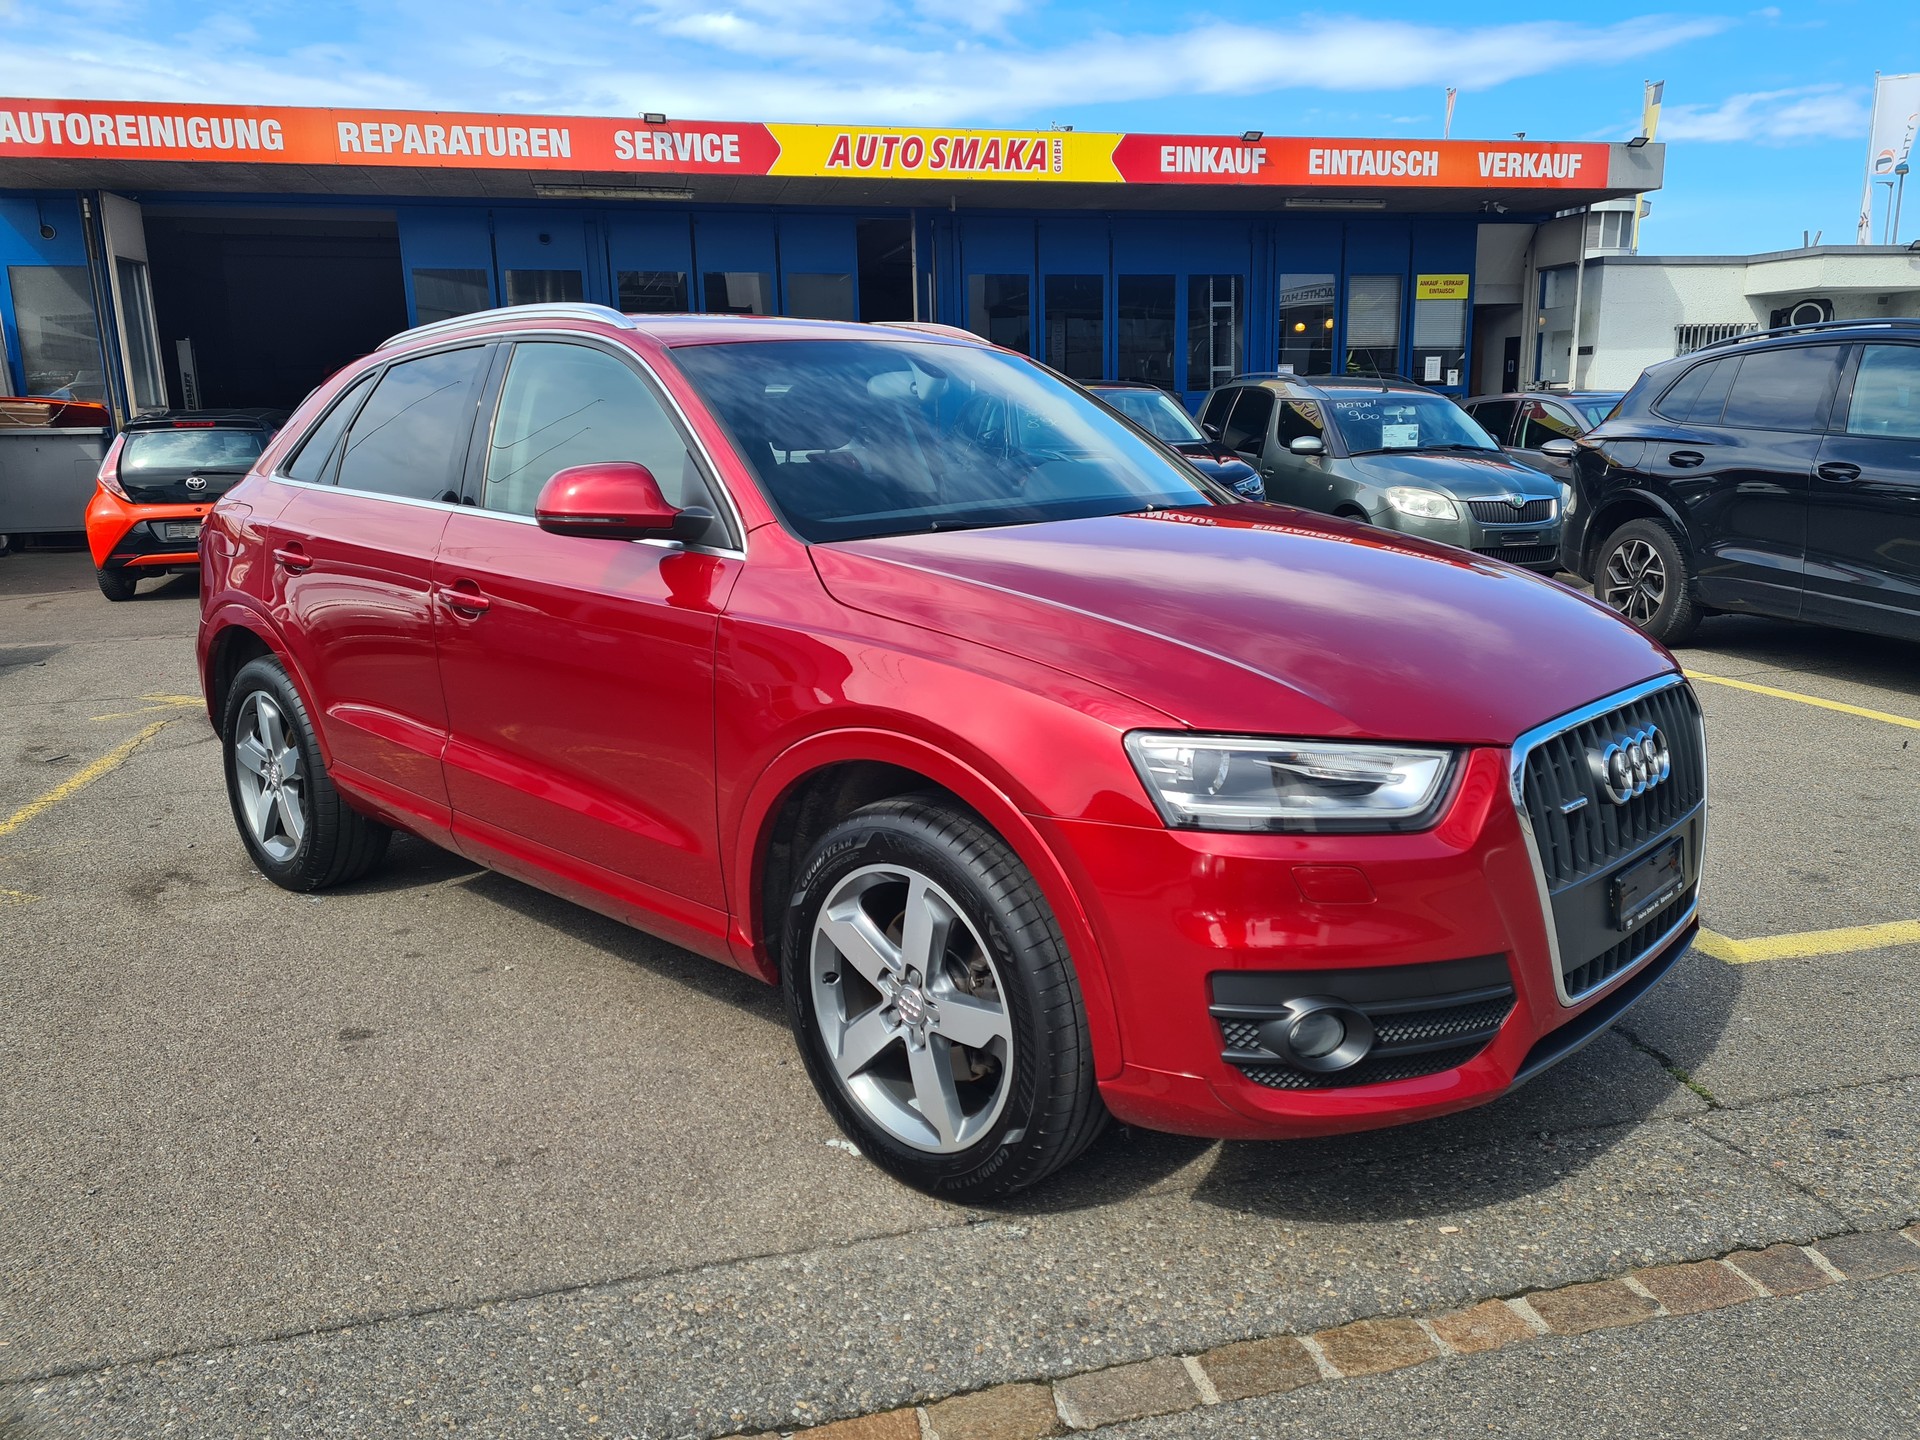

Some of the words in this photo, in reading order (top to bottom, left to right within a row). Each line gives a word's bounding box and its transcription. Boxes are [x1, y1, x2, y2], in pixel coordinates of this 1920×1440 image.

[0, 110, 285, 151] AUTOREINIGUNG
[337, 121, 571, 158] REPARATUREN
[614, 129, 740, 163] SERVICE
[825, 133, 926, 170] AUTO
[928, 136, 1049, 173] SMAKA
[1053, 138, 1062, 173] GMBH
[1160, 145, 1267, 175] EINKAUF
[1308, 148, 1439, 177] EINTAUSCH
[1478, 151, 1583, 180] VERKAUF
